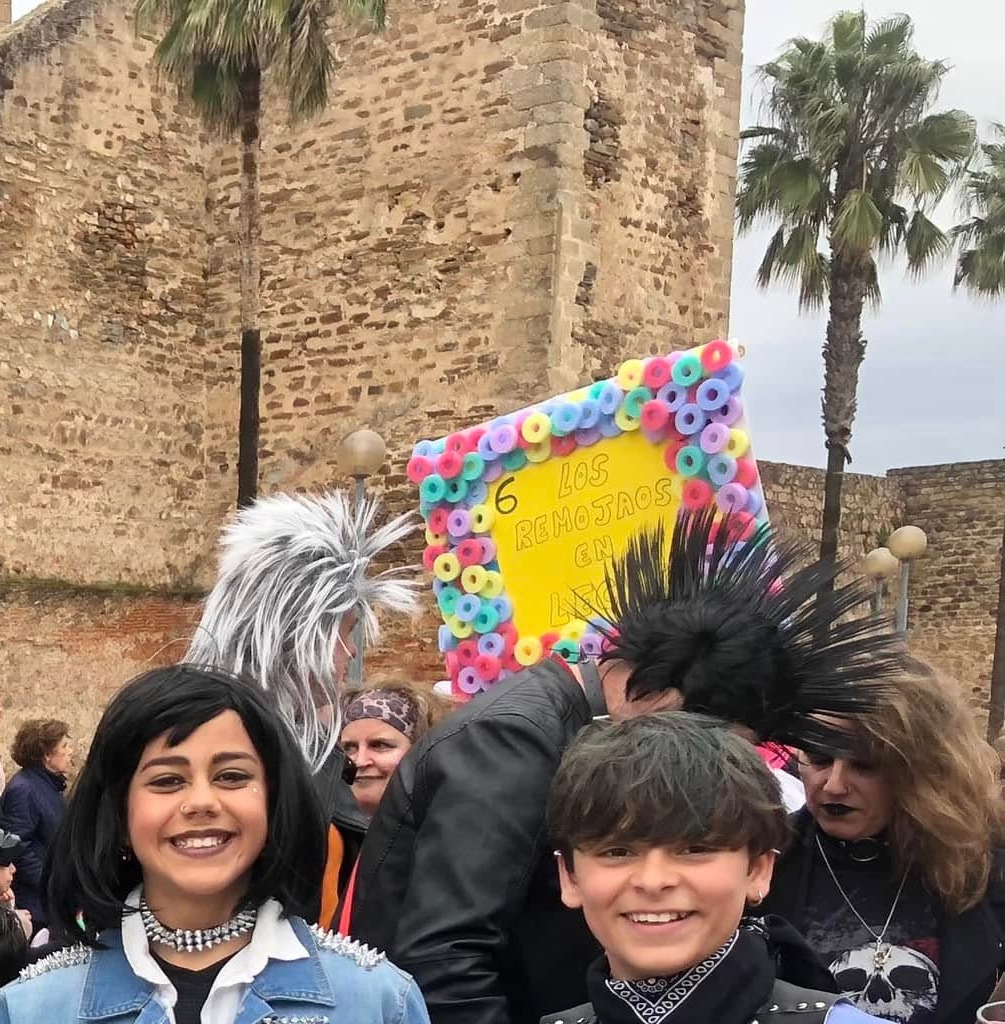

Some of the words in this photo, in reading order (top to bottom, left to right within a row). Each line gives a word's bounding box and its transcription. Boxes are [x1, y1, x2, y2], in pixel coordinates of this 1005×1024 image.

[495, 476, 518, 515] 6
[558, 453, 610, 499] LOS
[514, 478, 673, 551] REMOJAOS
[574, 535, 614, 568] EN
